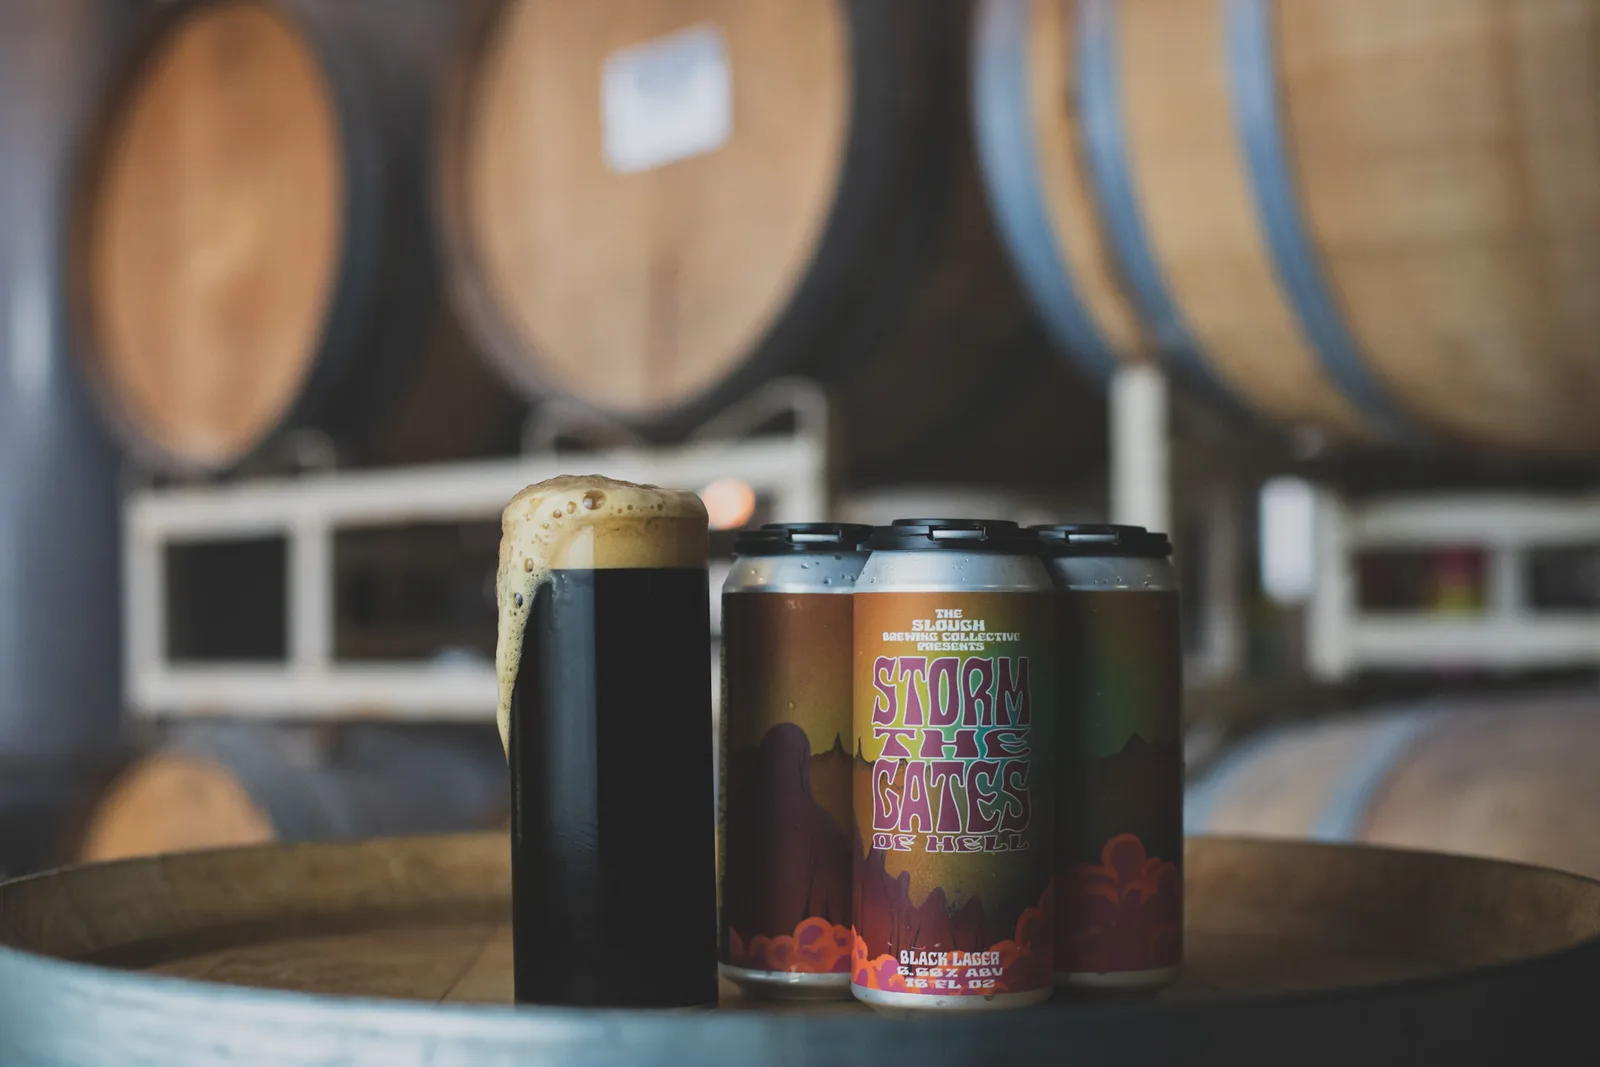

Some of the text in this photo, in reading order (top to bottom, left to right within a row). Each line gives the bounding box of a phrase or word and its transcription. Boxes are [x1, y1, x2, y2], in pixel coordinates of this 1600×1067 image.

[934, 608, 963, 619] THE
[911, 619, 986, 632] SLOUGH
[882, 632, 1021, 642] BREWING COLLECTIVE
[917, 642, 985, 651] PRESENTS
[872, 656, 1032, 727] STORM
[873, 727, 1032, 759] THE
[872, 759, 1032, 834] GATES
[873, 833, 1030, 853] OF HELL
[900, 950, 1000, 967] BLACK LAGER
[896, 966, 1004, 978] 6.66% ABV
[905, 978, 995, 989] 16 FL OZ
